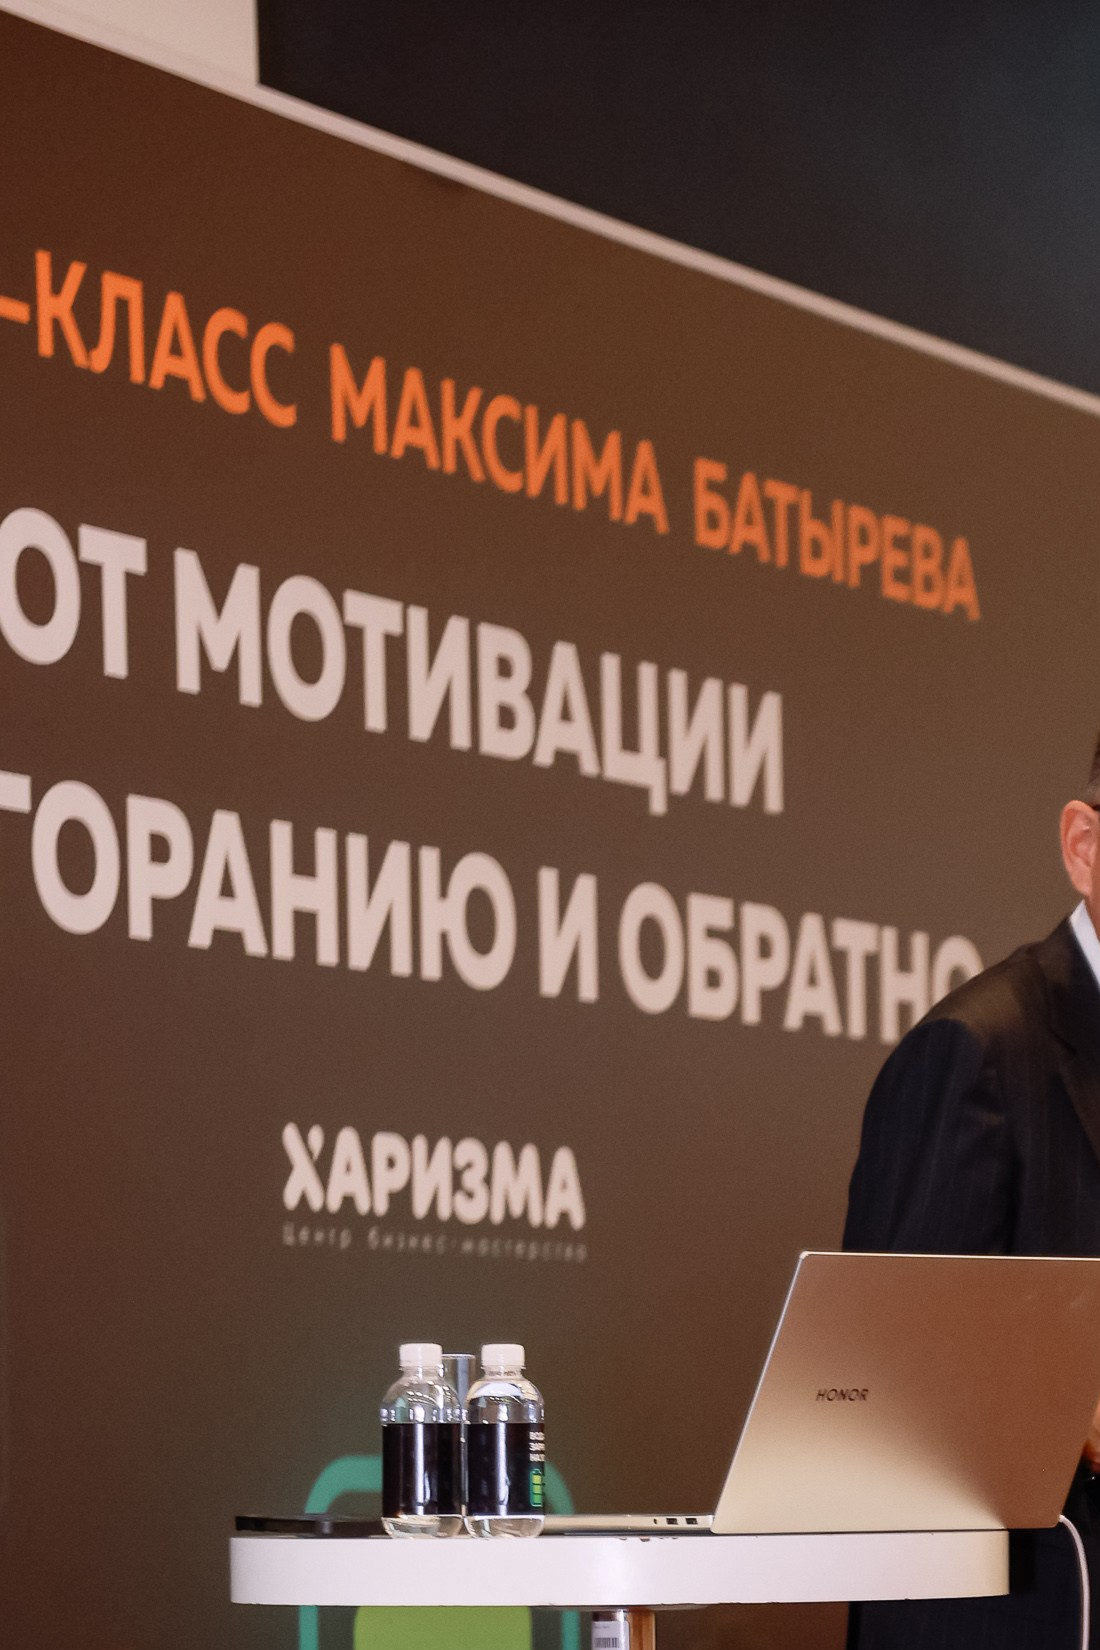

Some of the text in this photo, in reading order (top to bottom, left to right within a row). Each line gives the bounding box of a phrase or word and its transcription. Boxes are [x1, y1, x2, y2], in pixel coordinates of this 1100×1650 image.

[330, 343, 669, 533] МАКСИМА
[694, 458, 981, 621] БАТЫРЕВА
[0, 507, 784, 815] ОТ МОТИВАЦИИ
[537, 867, 599, 1003] И
[282, 1122, 587, 1230] ХАРИЗМА
[815, 1388, 869, 1402] HONOR
